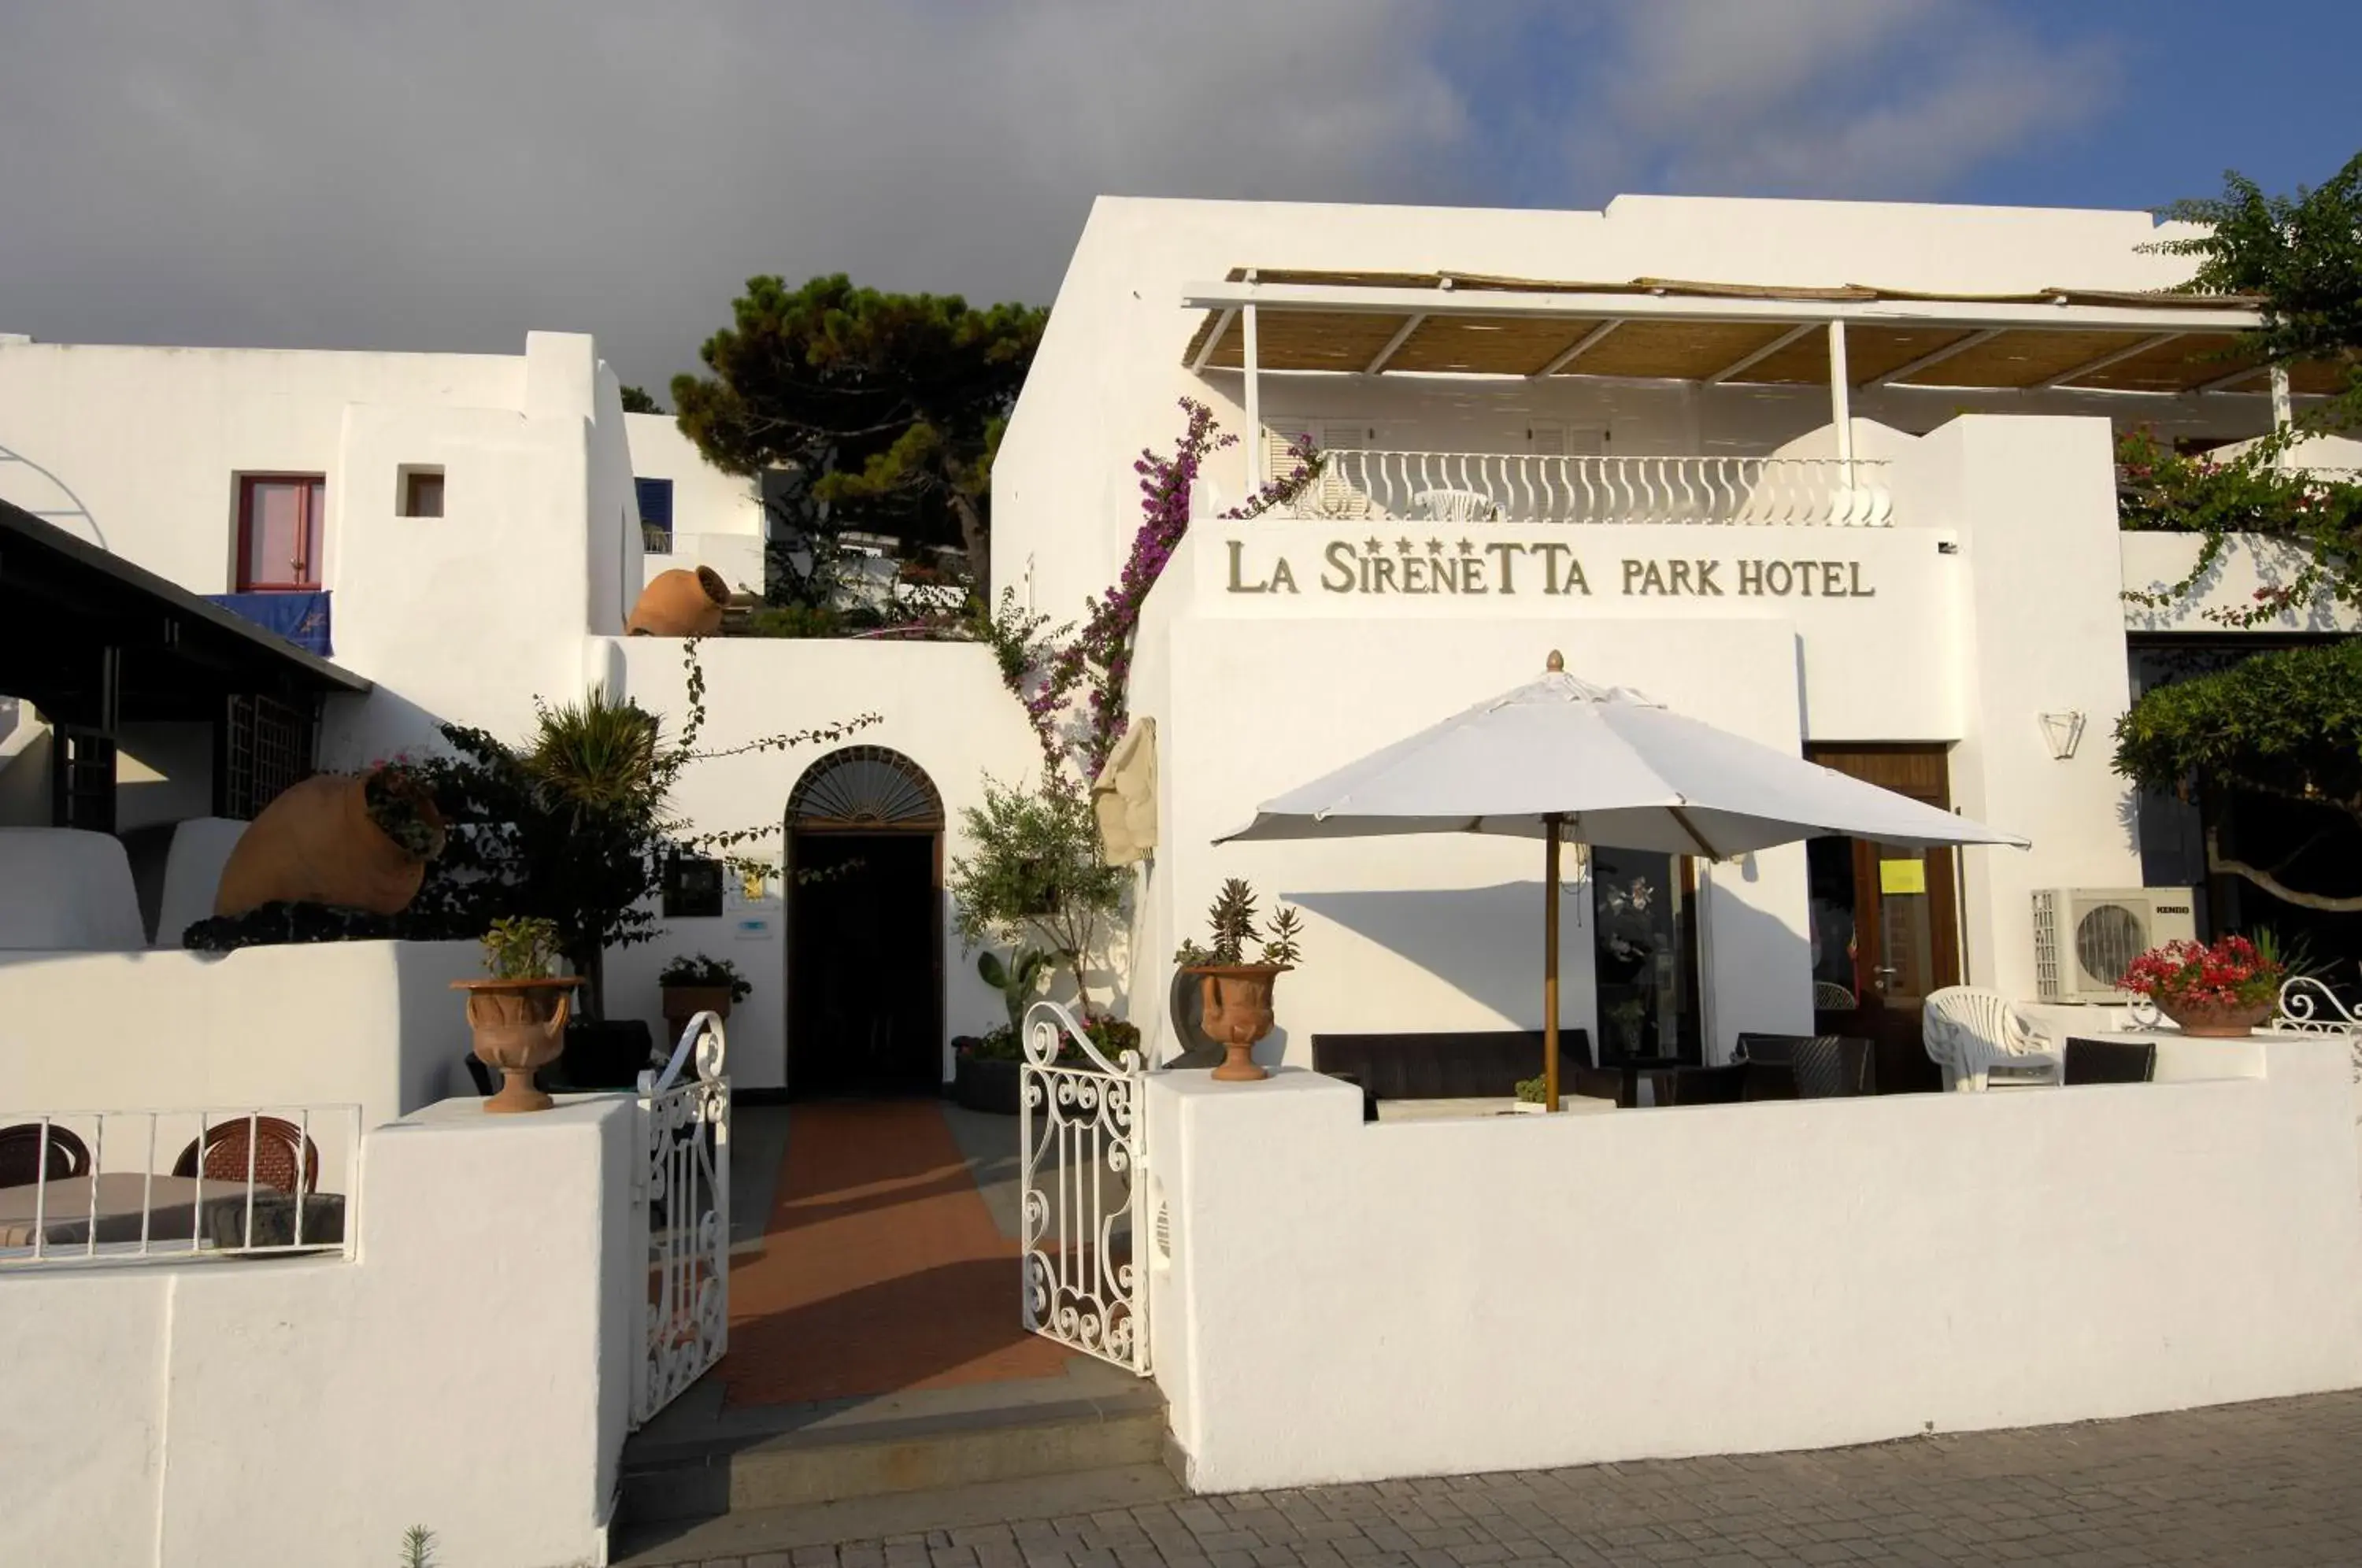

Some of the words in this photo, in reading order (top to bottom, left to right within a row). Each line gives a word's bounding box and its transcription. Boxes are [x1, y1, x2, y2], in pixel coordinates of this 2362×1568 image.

[1226, 540, 1300, 594] LA
[1320, 541, 1592, 596] SIRENETTA
[1621, 559, 1724, 596] PARK
[1737, 560, 1876, 597] HOTEL
